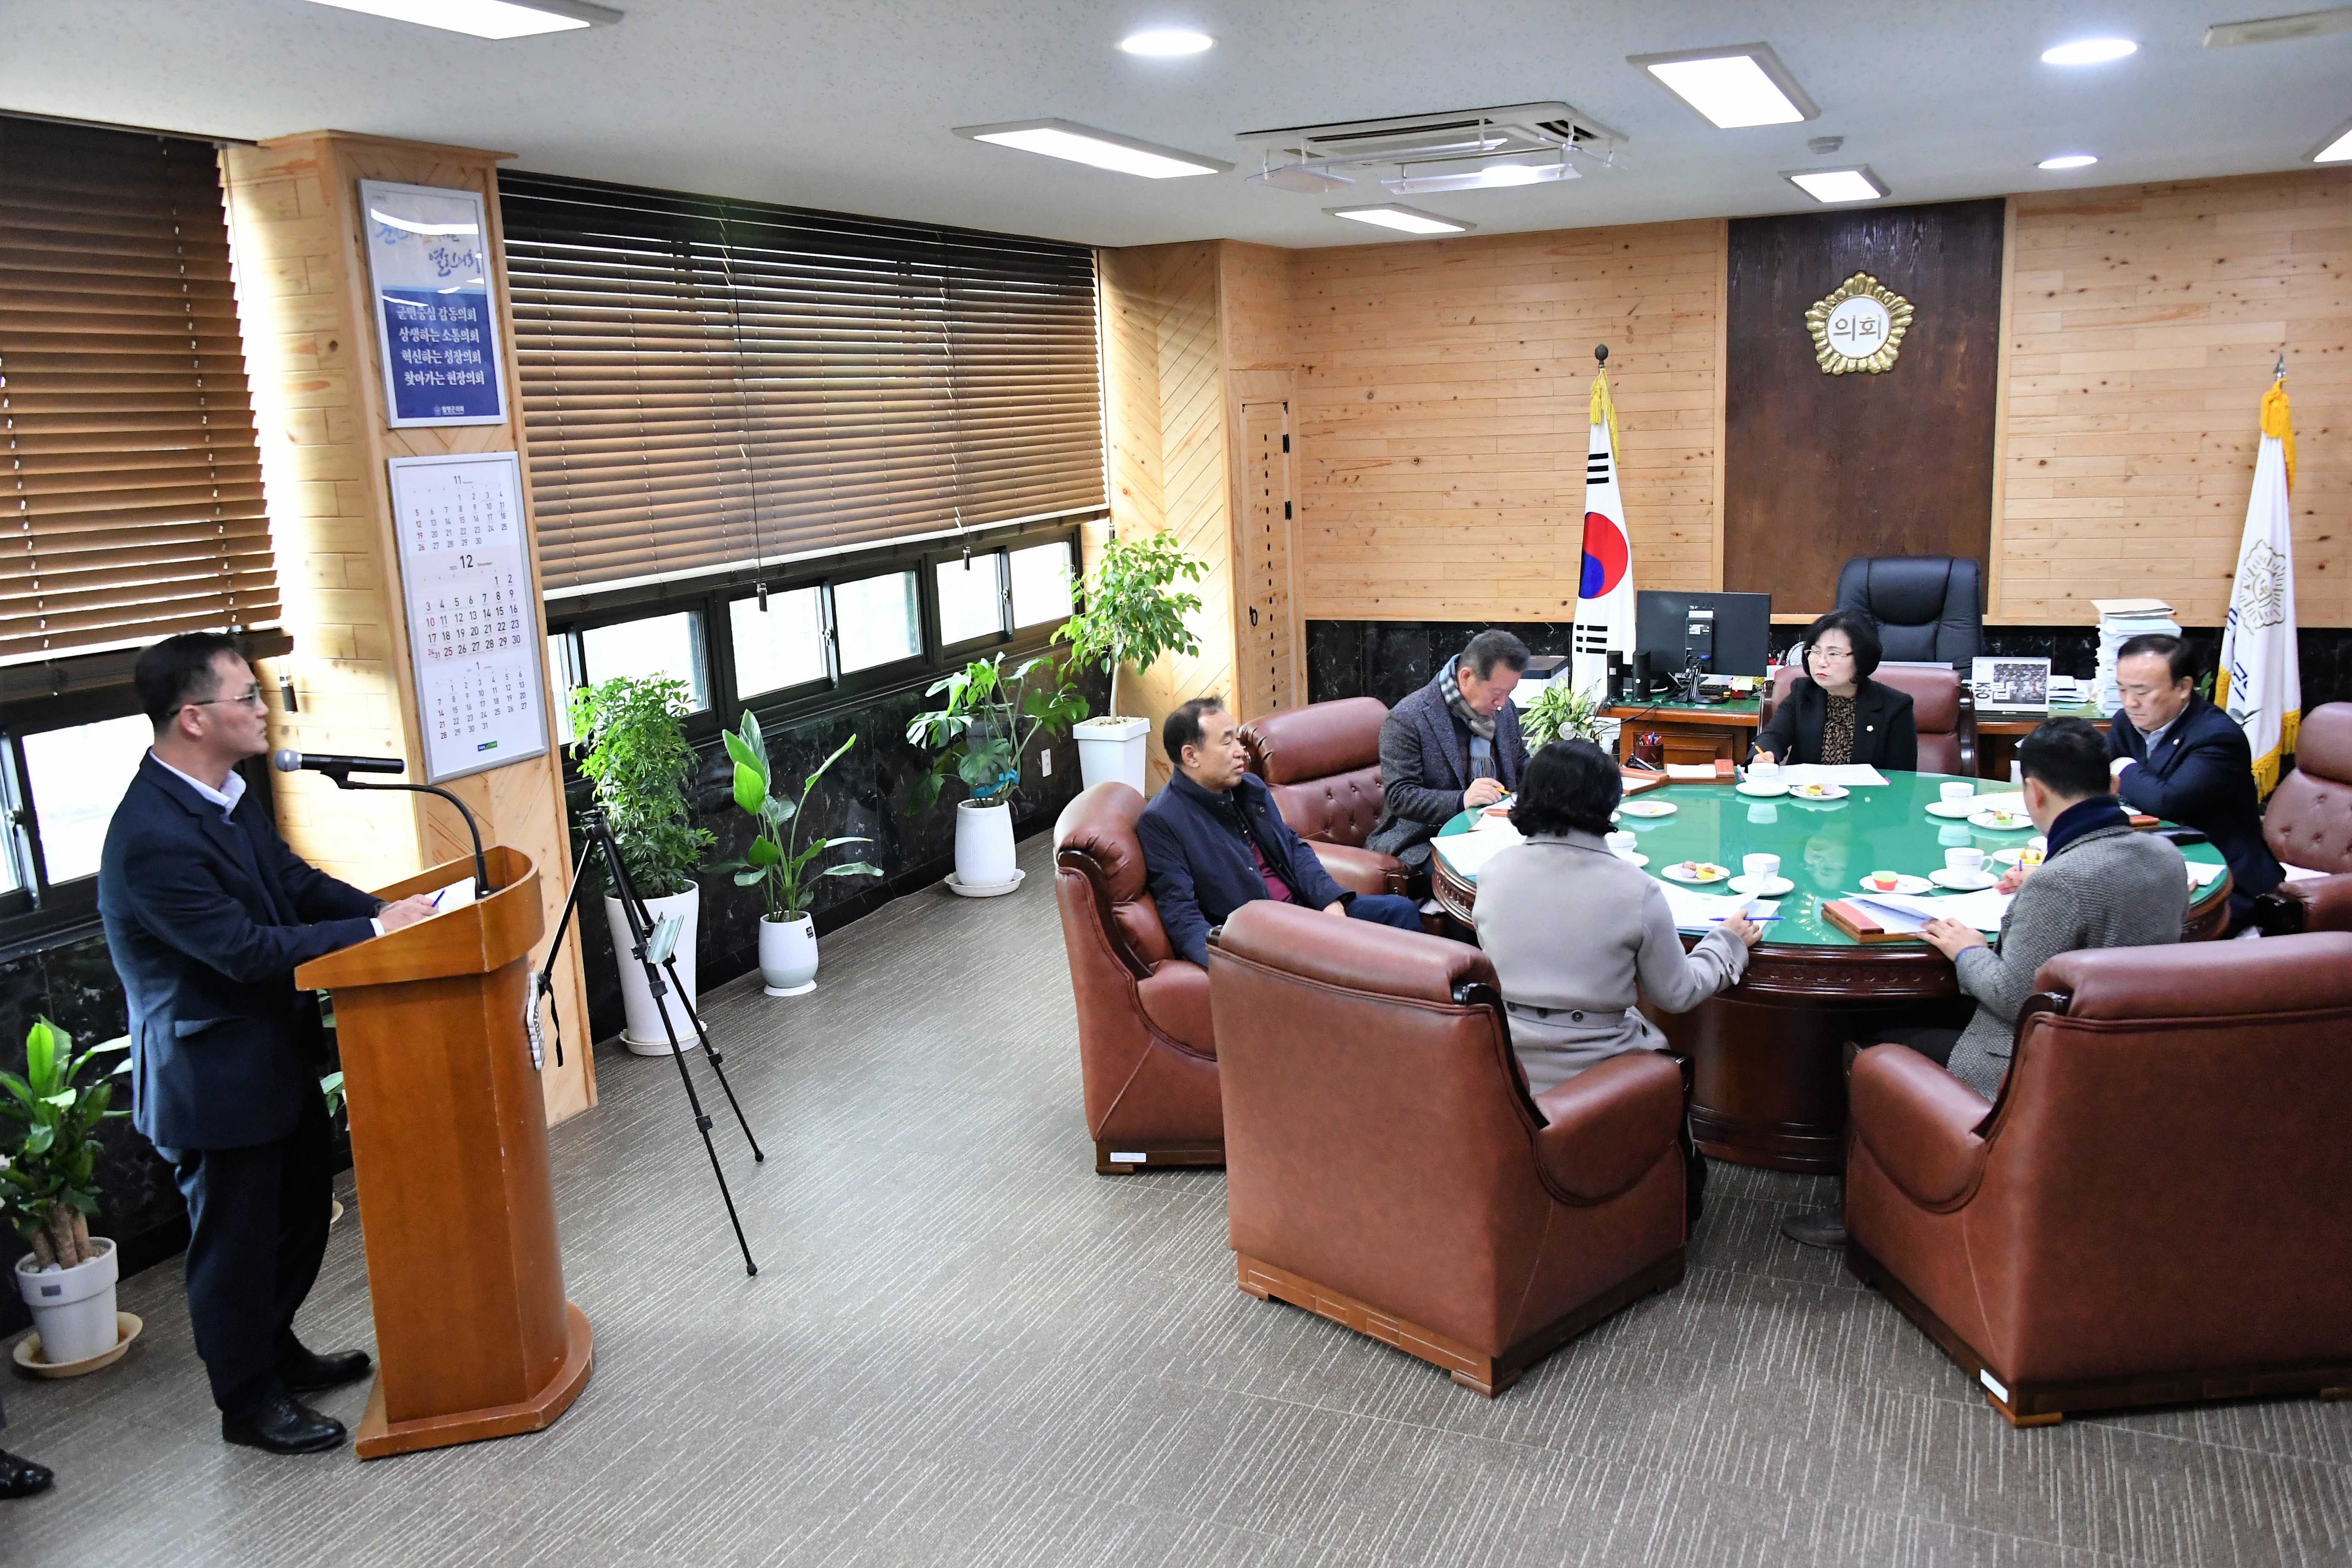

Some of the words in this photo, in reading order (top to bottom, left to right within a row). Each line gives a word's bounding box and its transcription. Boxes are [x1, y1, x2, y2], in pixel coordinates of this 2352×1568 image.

[397, 305, 436, 321] 군민중심
[438, 306, 477, 322] 감동의회
[399, 327, 440, 343] 상생하는
[442, 328, 480, 343] 소통의회
[1833, 313, 1881, 341] 의회
[401, 348, 443, 364] 혁신하는
[444, 349, 482, 364] 성장의회
[404, 370, 446, 386] 찾아가는
[446, 370, 485, 385] 현장의회
[454, 476, 461, 484] 11
[460, 555, 474, 569] 12
[494, 576, 498, 585] 1
[508, 574, 512, 583] 2
[426, 602, 431, 611] 3
[440, 600, 445, 608] 4
[455, 598, 459, 606] 5
[469, 596, 473, 604] 6
[482, 593, 487, 602] 7
[496, 592, 501, 600] 8
[509, 590, 514, 598] 9
[426, 618, 435, 627] 10
[440, 615, 447, 625] 11
[455, 613, 464, 622] 12
[469, 611, 477, 620] 13
[483, 609, 491, 618] 14
[495, 607, 504, 615] 15
[509, 605, 518, 613] 16
[428, 633, 436, 643] 17
[442, 632, 450, 640] 18
[457, 629, 465, 638] 19
[470, 626, 479, 636] 20
[484, 624, 492, 634] 21
[497, 622, 506, 631] 22
[511, 620, 520, 629] 23
[444, 647, 453, 656] 25
[458, 645, 467, 654] 26
[471, 642, 480, 651] 27
[485, 640, 494, 649] 28
[499, 637, 507, 646] 29
[512, 635, 521, 644] 30
[476, 662, 480, 670] 1
